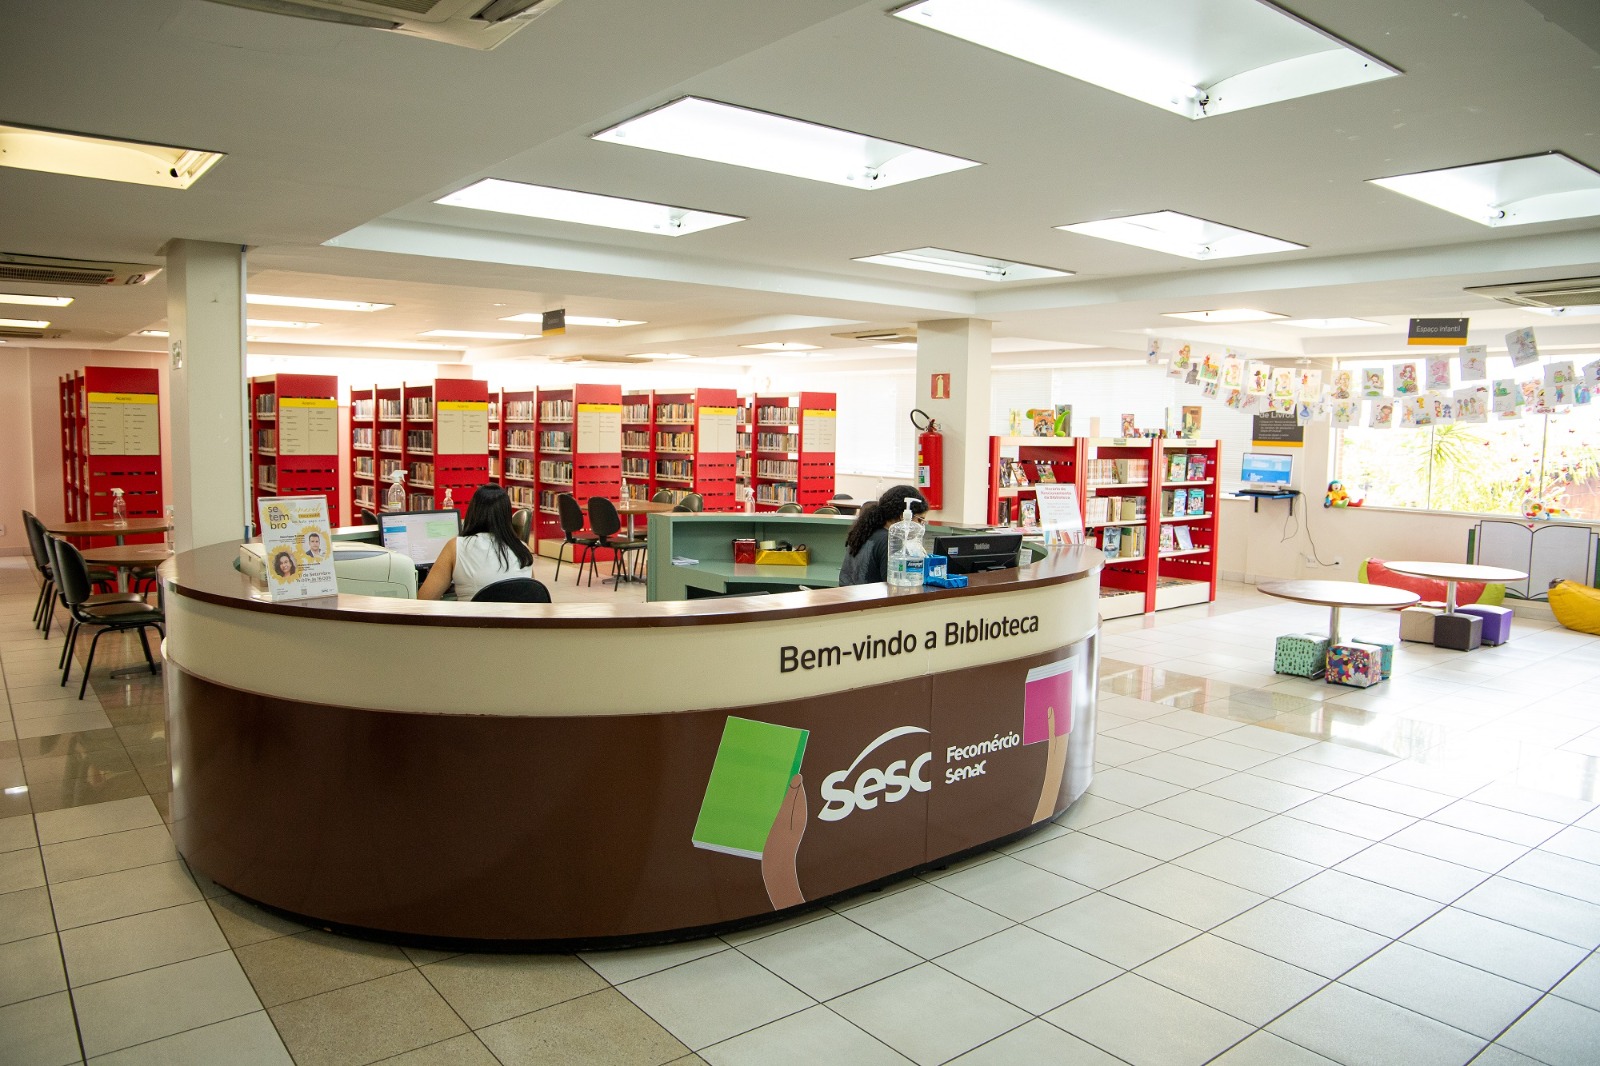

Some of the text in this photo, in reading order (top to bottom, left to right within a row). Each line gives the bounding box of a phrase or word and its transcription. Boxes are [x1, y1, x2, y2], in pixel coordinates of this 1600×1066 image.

[1416, 325, 1438, 333] Espaço
[1271, 411, 1295, 419] Livros
[269, 513, 290, 521] tem
[270, 522, 287, 530] bro
[780, 615, 1039, 673] Bem-vindo a Biblioteca
[946, 731, 1020, 763] Fecomércio
[944, 760, 986, 785] Senac
